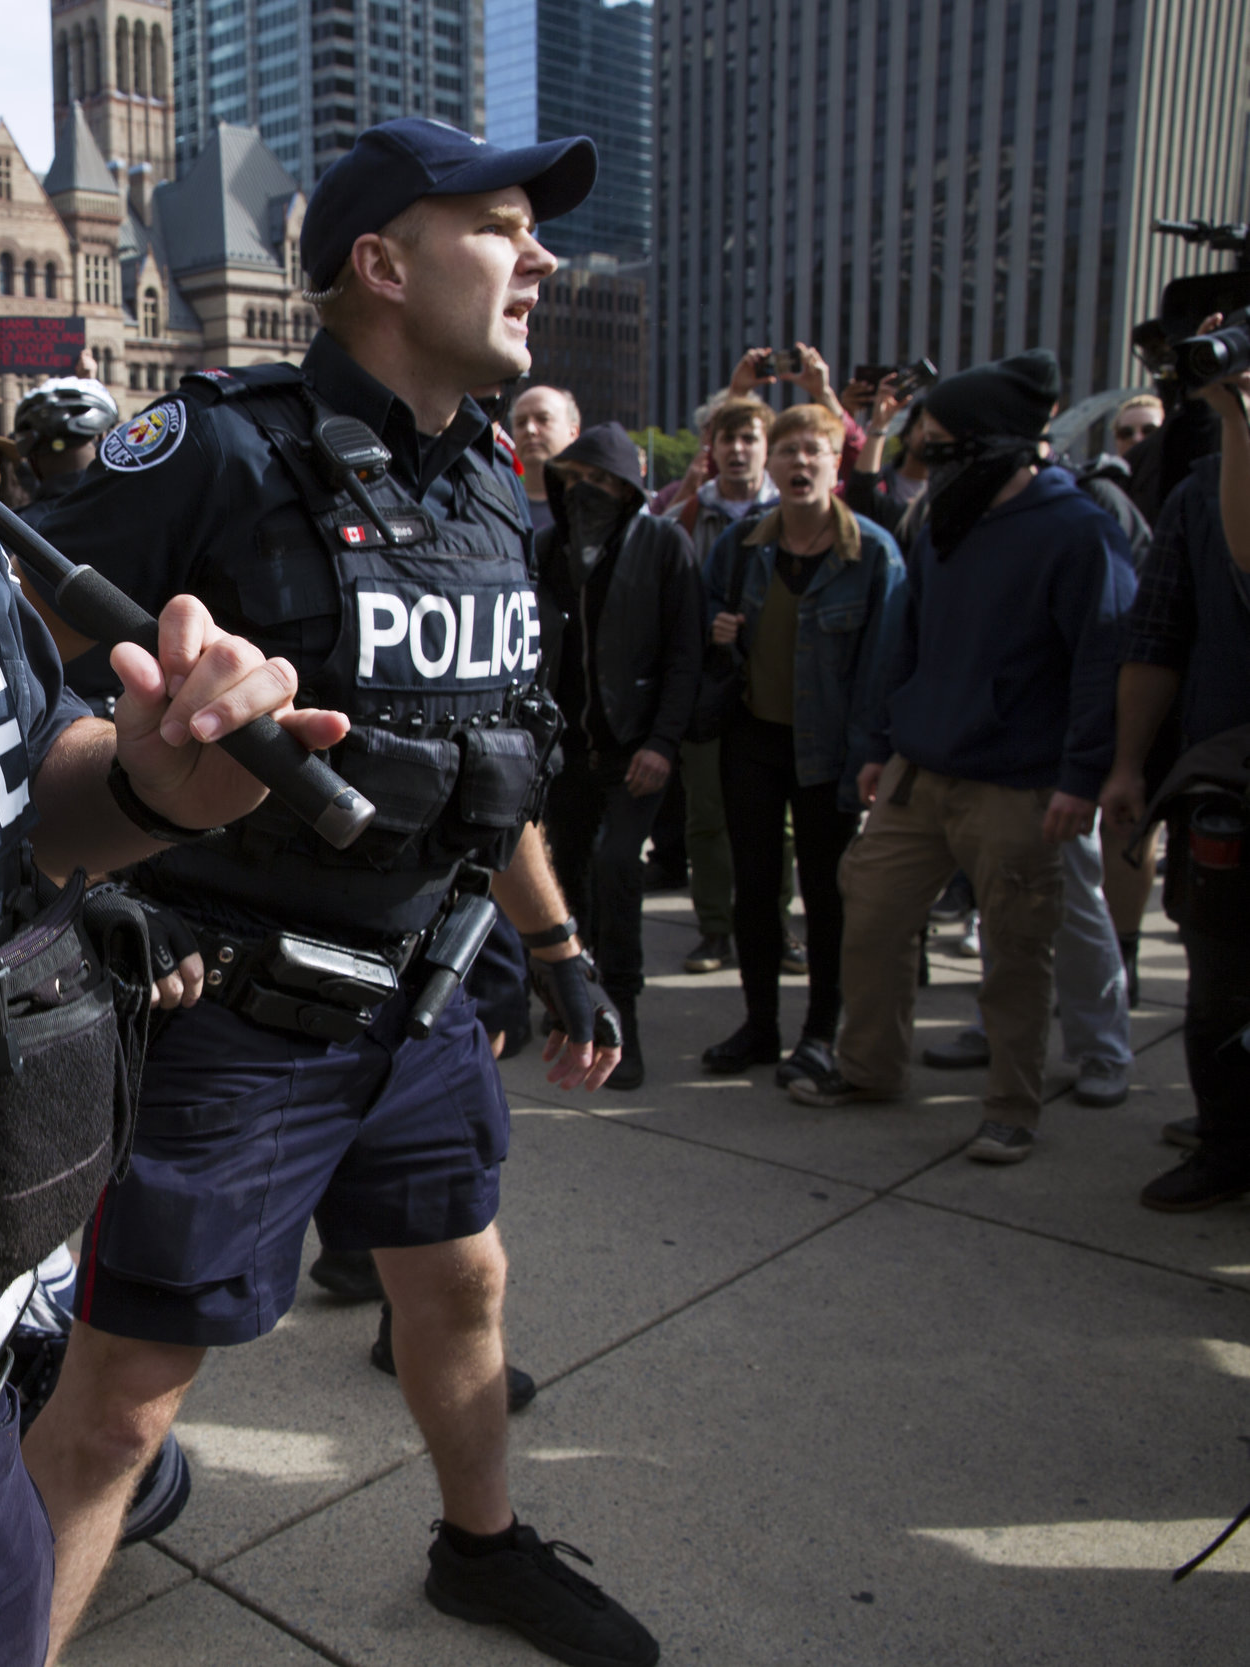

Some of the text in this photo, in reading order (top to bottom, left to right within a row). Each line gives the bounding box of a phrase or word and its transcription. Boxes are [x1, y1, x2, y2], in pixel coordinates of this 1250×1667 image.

[37, 318, 65, 330] YOU
[16, 342, 55, 354] YOUR
[14, 354, 72, 367] RALLIES
[105, 436, 133, 466] POLICE
[357, 591, 541, 679] POLICE
